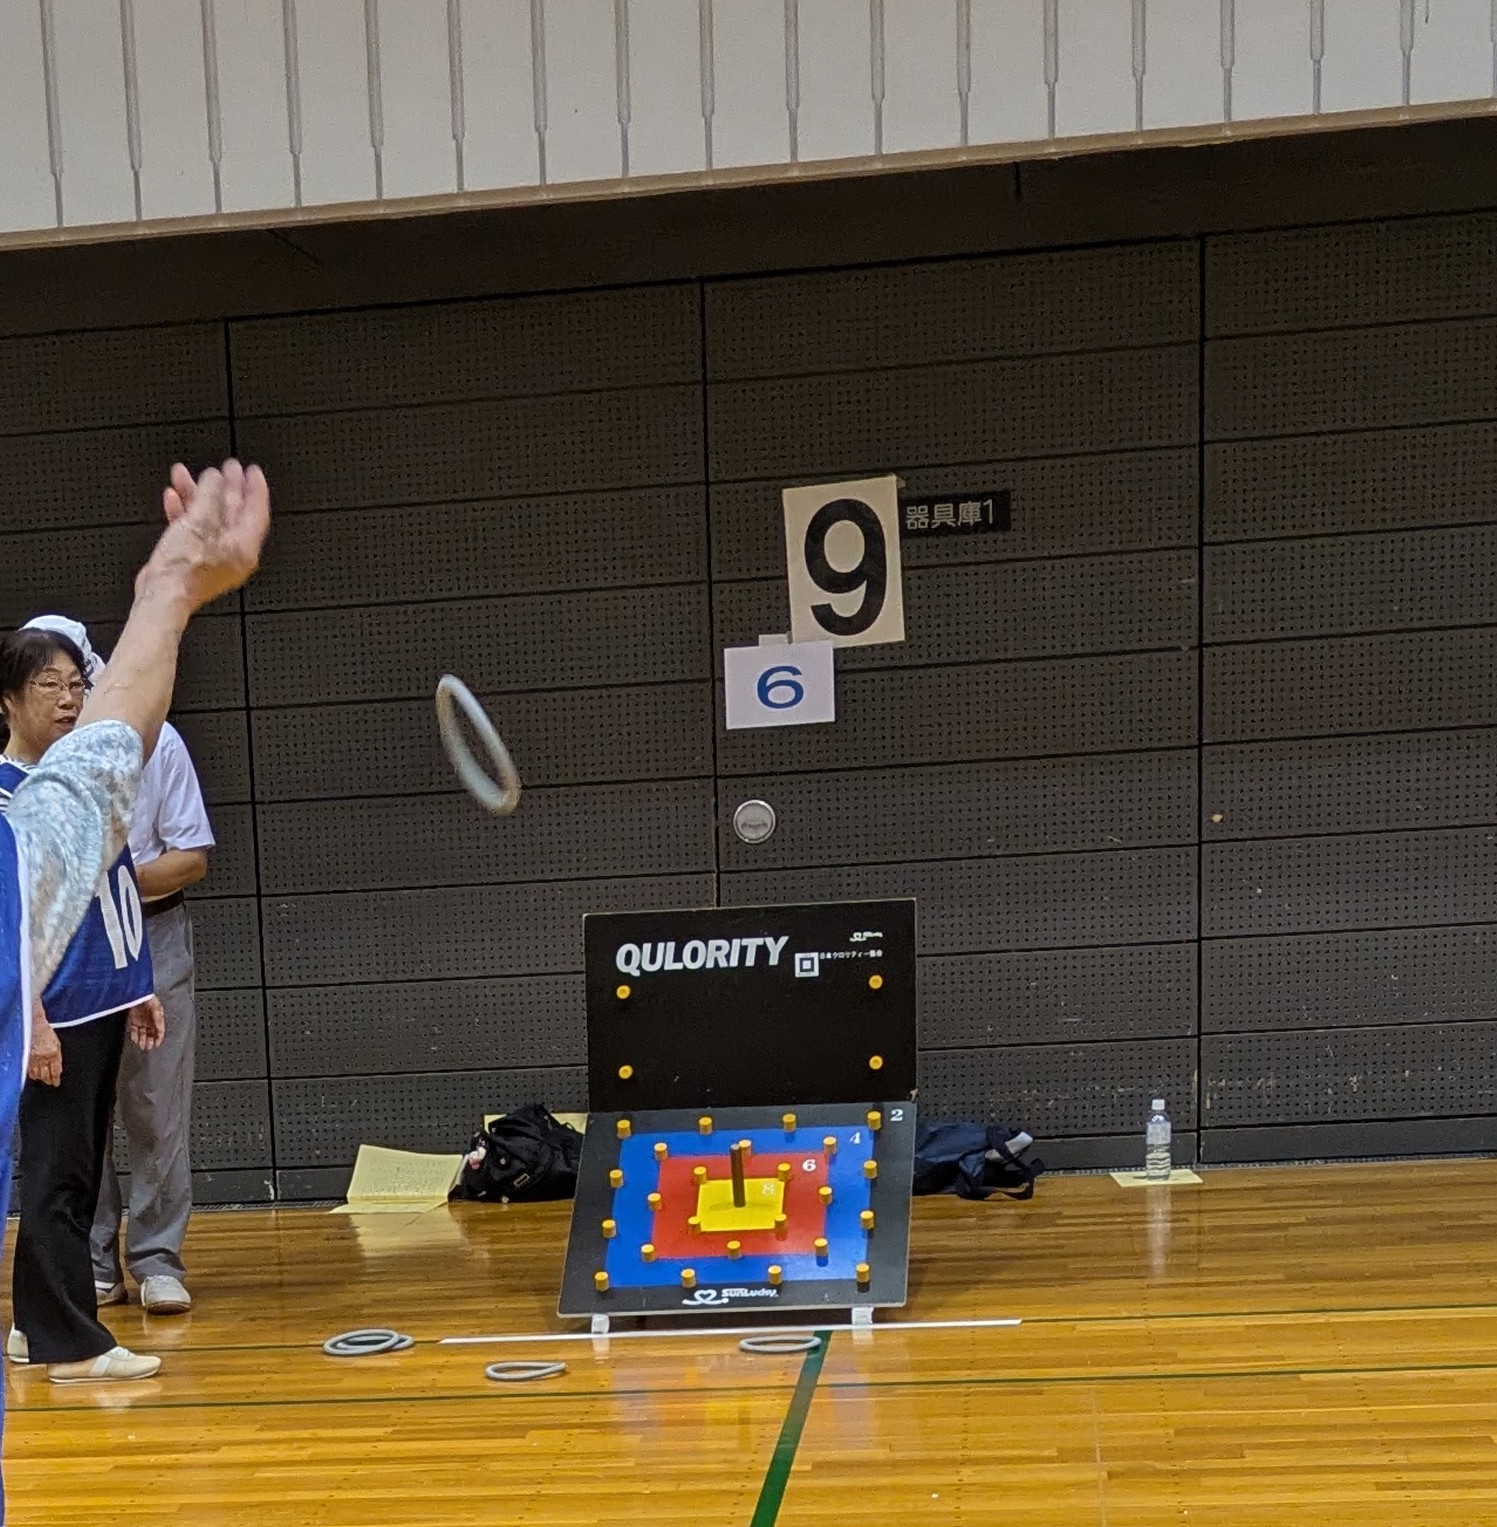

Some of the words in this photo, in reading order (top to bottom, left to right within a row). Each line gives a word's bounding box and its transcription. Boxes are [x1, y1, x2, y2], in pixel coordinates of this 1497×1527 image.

[905, 498, 994, 530] 器具庫1
[804, 498, 888, 636] 9
[756, 665, 804, 710] 6
[94, 864, 143, 970] 10
[615, 935, 789, 977] QULORITY
[890, 1109, 904, 1122] 2
[849, 1132, 862, 1145] 4
[802, 1159, 817, 1172] 6
